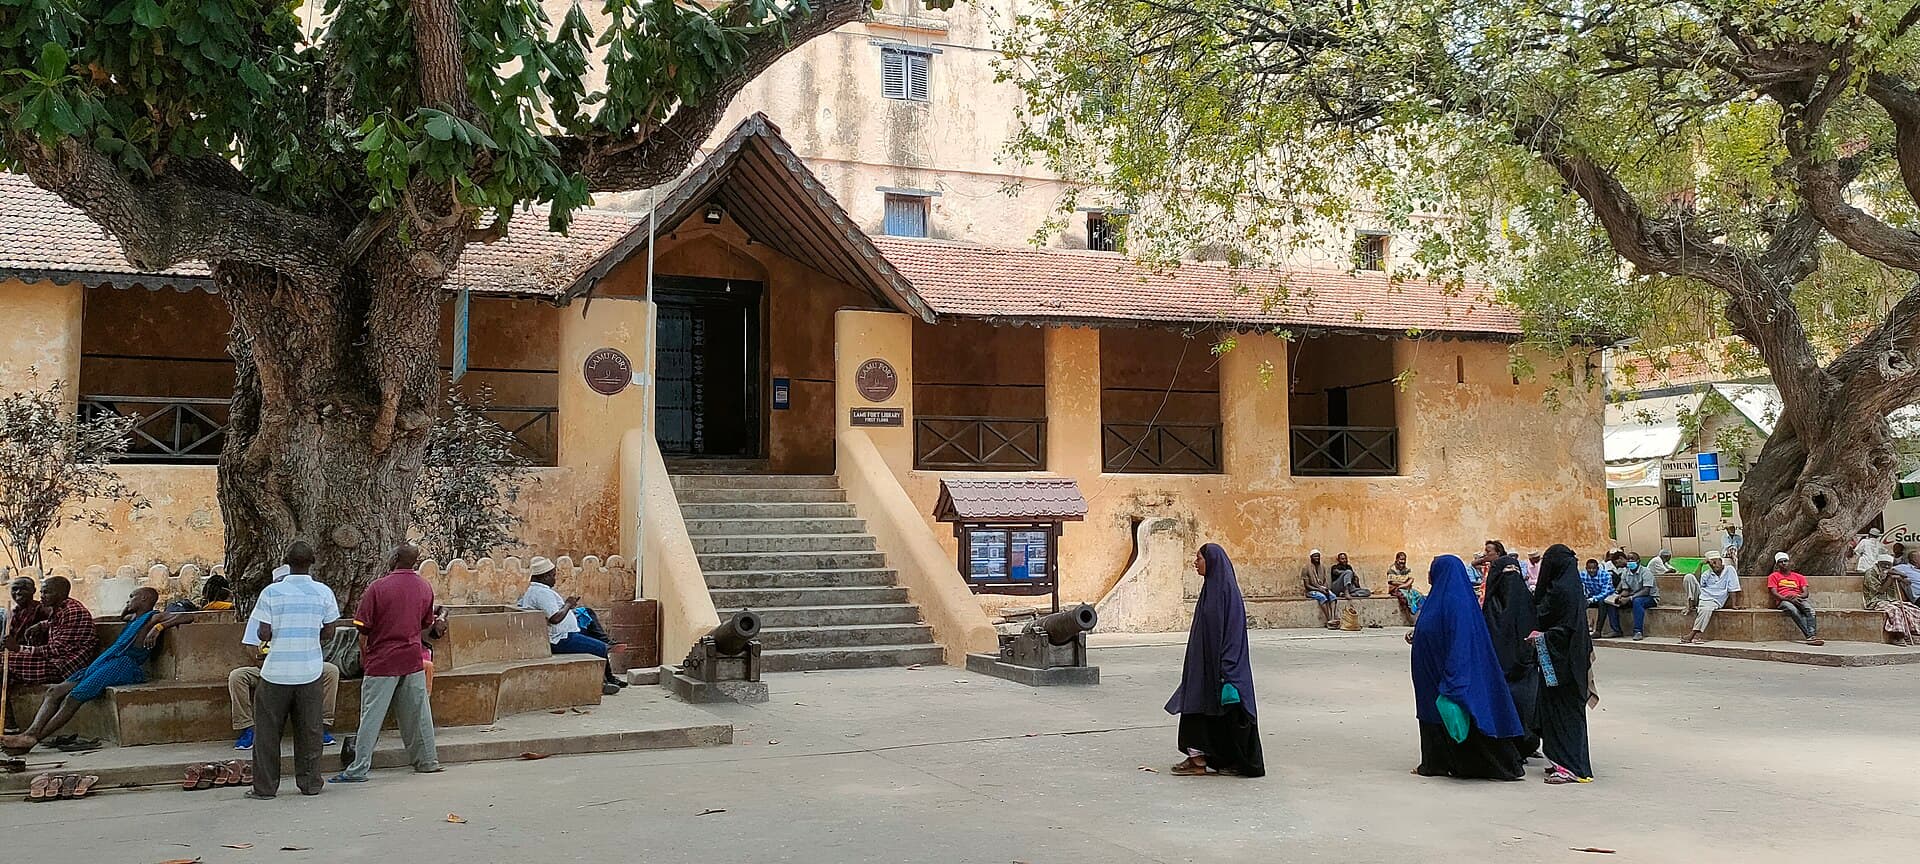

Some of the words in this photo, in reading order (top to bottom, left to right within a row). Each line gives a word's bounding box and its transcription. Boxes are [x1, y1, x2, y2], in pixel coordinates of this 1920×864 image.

[588, 352, 610, 370] LAMU
[611, 353, 627, 371] FORT
[859, 362, 878, 380] LAMU
[878, 362, 894, 379] FORT
[1662, 462, 1698, 470] OMMUNICA
[1615, 496, 1659, 506] M-PESA
[1696, 491, 1739, 503] M-PES
